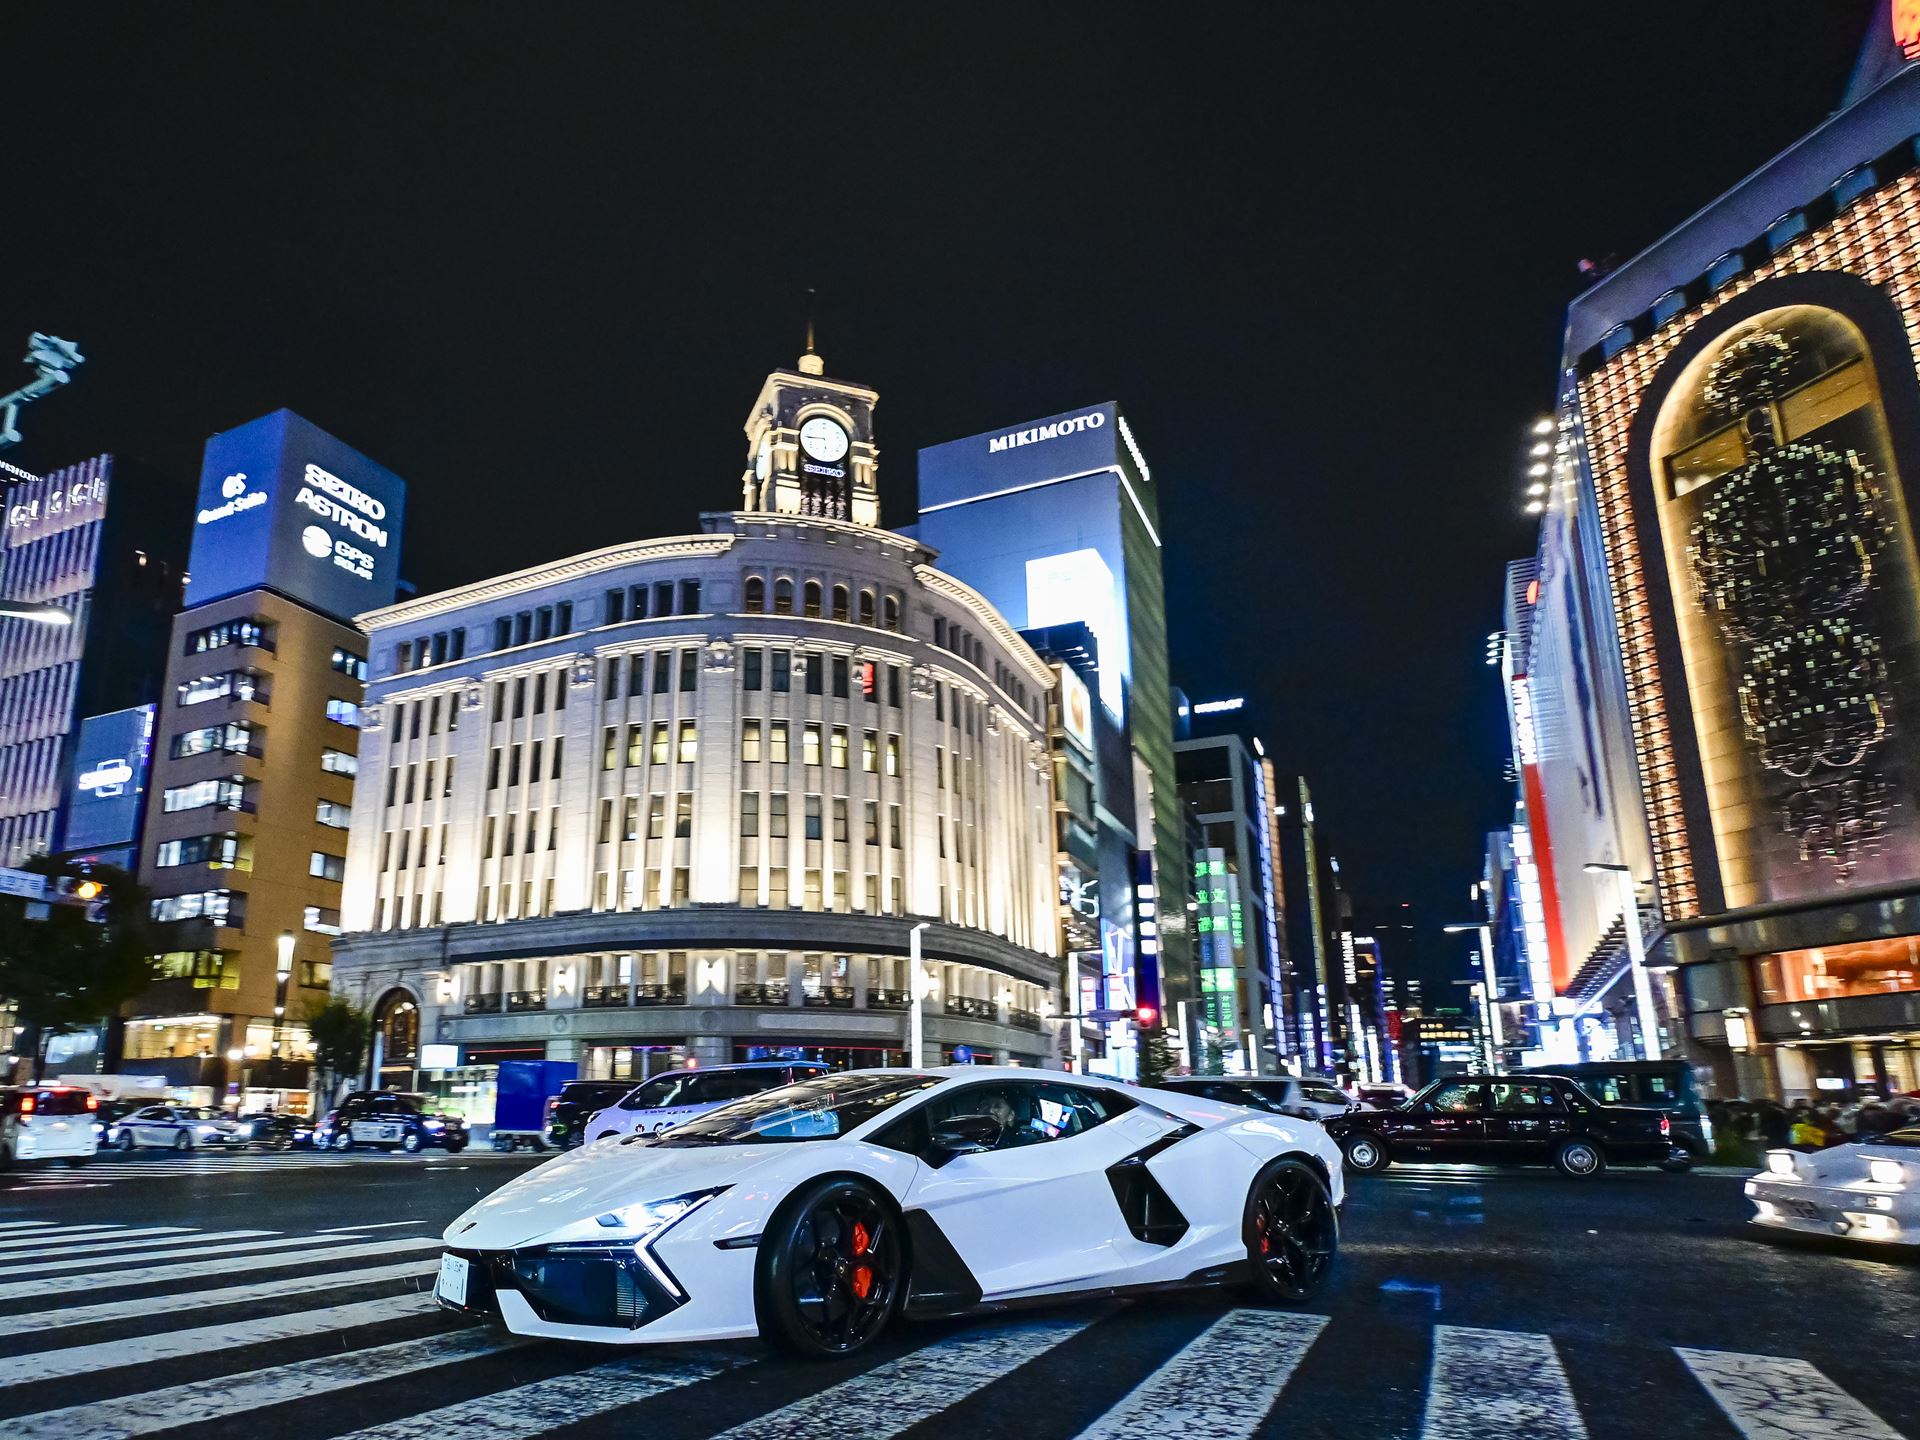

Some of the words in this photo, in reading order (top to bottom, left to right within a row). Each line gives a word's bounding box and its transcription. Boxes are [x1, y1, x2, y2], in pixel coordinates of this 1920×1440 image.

[989, 412, 1105, 453] MIKIMOTO
[803, 463, 846, 478] SEIKO
[304, 463, 386, 520] SEIKO
[295, 487, 387, 547] ASTRON
[333, 555, 372, 580] SOLAR
[334, 540, 374, 569] GPS
